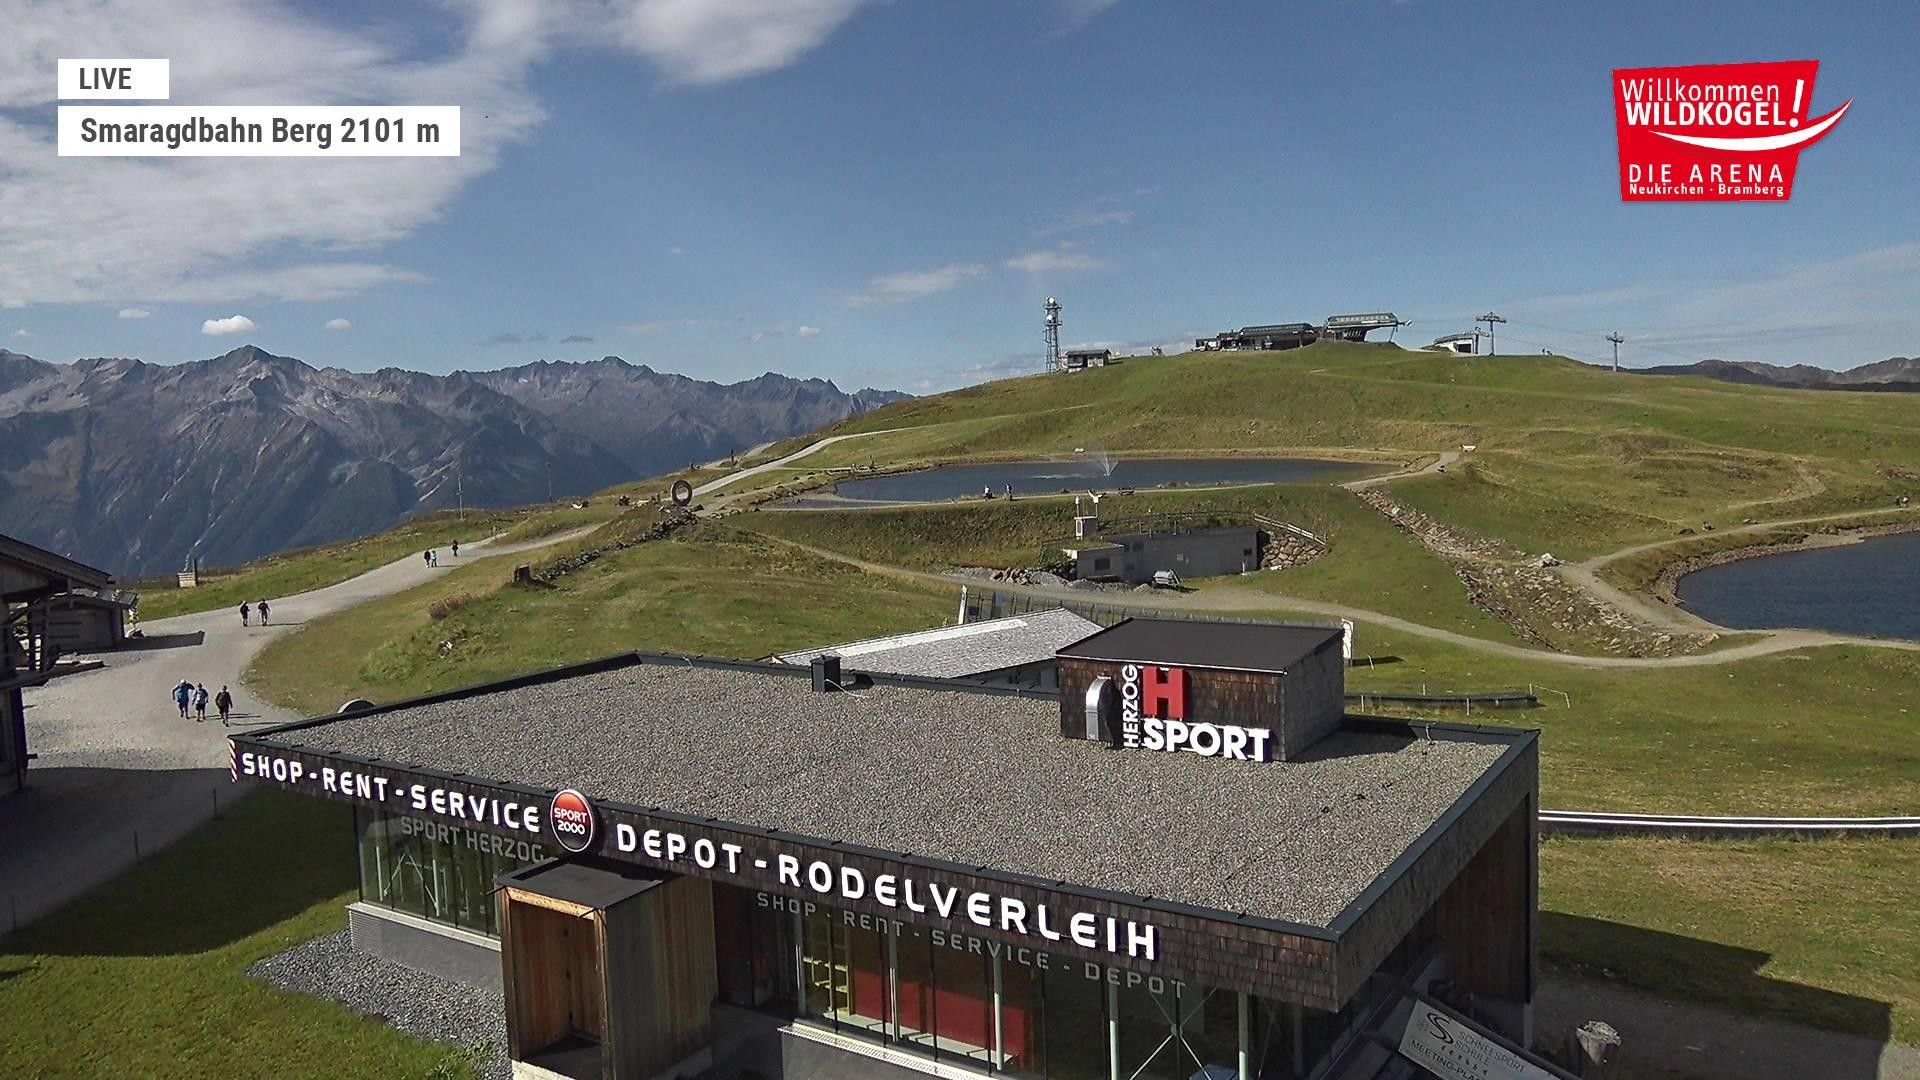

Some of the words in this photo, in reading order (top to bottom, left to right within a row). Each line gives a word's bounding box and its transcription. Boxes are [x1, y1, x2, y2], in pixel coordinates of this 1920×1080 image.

[1122, 664, 1139, 748] HERZOG
[1142, 665, 1184, 719] H
[1142, 718, 1270, 762] SPORT
[242, 752, 303, 783] SHOP
[322, 767, 388, 801] RENT
[410, 784, 540, 833] SERVICE
[554, 807, 588, 822] SPORT
[400, 815, 461, 846] SPORT
[466, 829, 546, 864] HERZOG
[558, 820, 586, 835] 2000
[616, 823, 743, 874] DEPOT
[778, 853, 1156, 961] RODELVERLEIH
[756, 892, 817, 917] SHOP
[843, 910, 905, 937] RENT
[931, 929, 1050, 970] SERVICE
[1084, 961, 1186, 999] DEPOT
